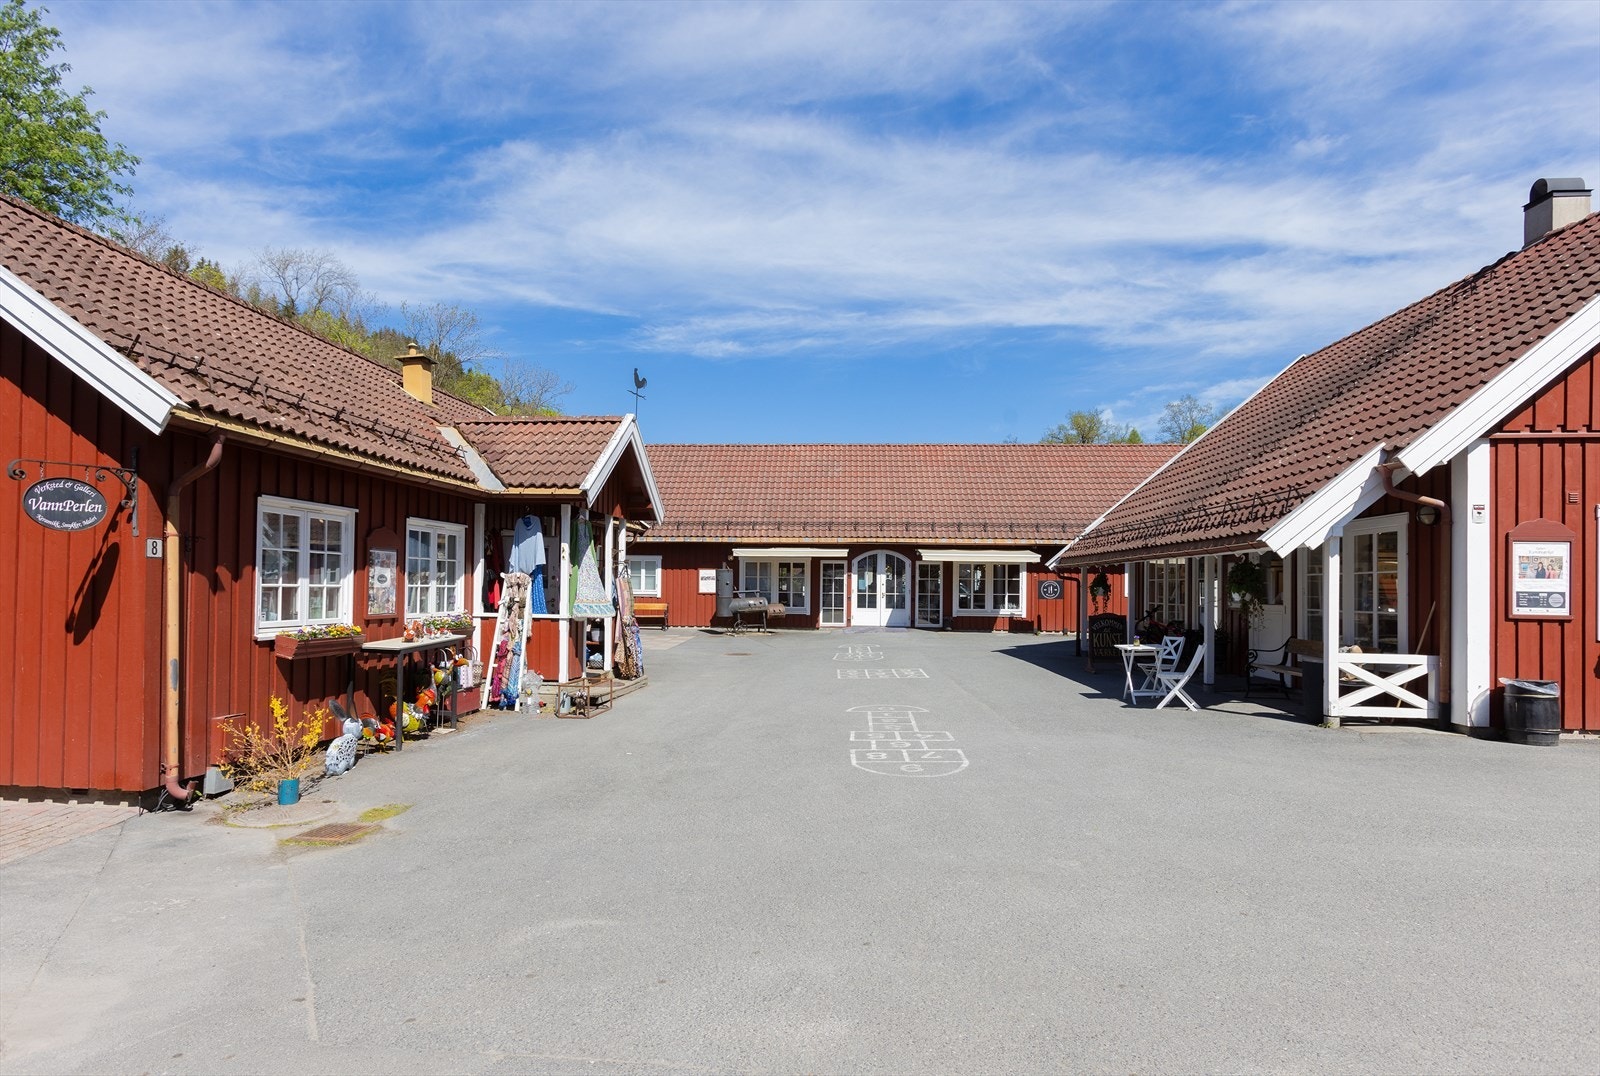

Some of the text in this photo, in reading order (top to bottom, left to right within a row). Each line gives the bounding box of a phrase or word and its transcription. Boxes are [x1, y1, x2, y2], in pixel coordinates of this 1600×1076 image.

[34, 480, 64, 494] Verksted
[74, 483, 97, 498] Galleri
[28, 497, 103, 513] VannPerlen
[151, 540, 158, 556] 8
